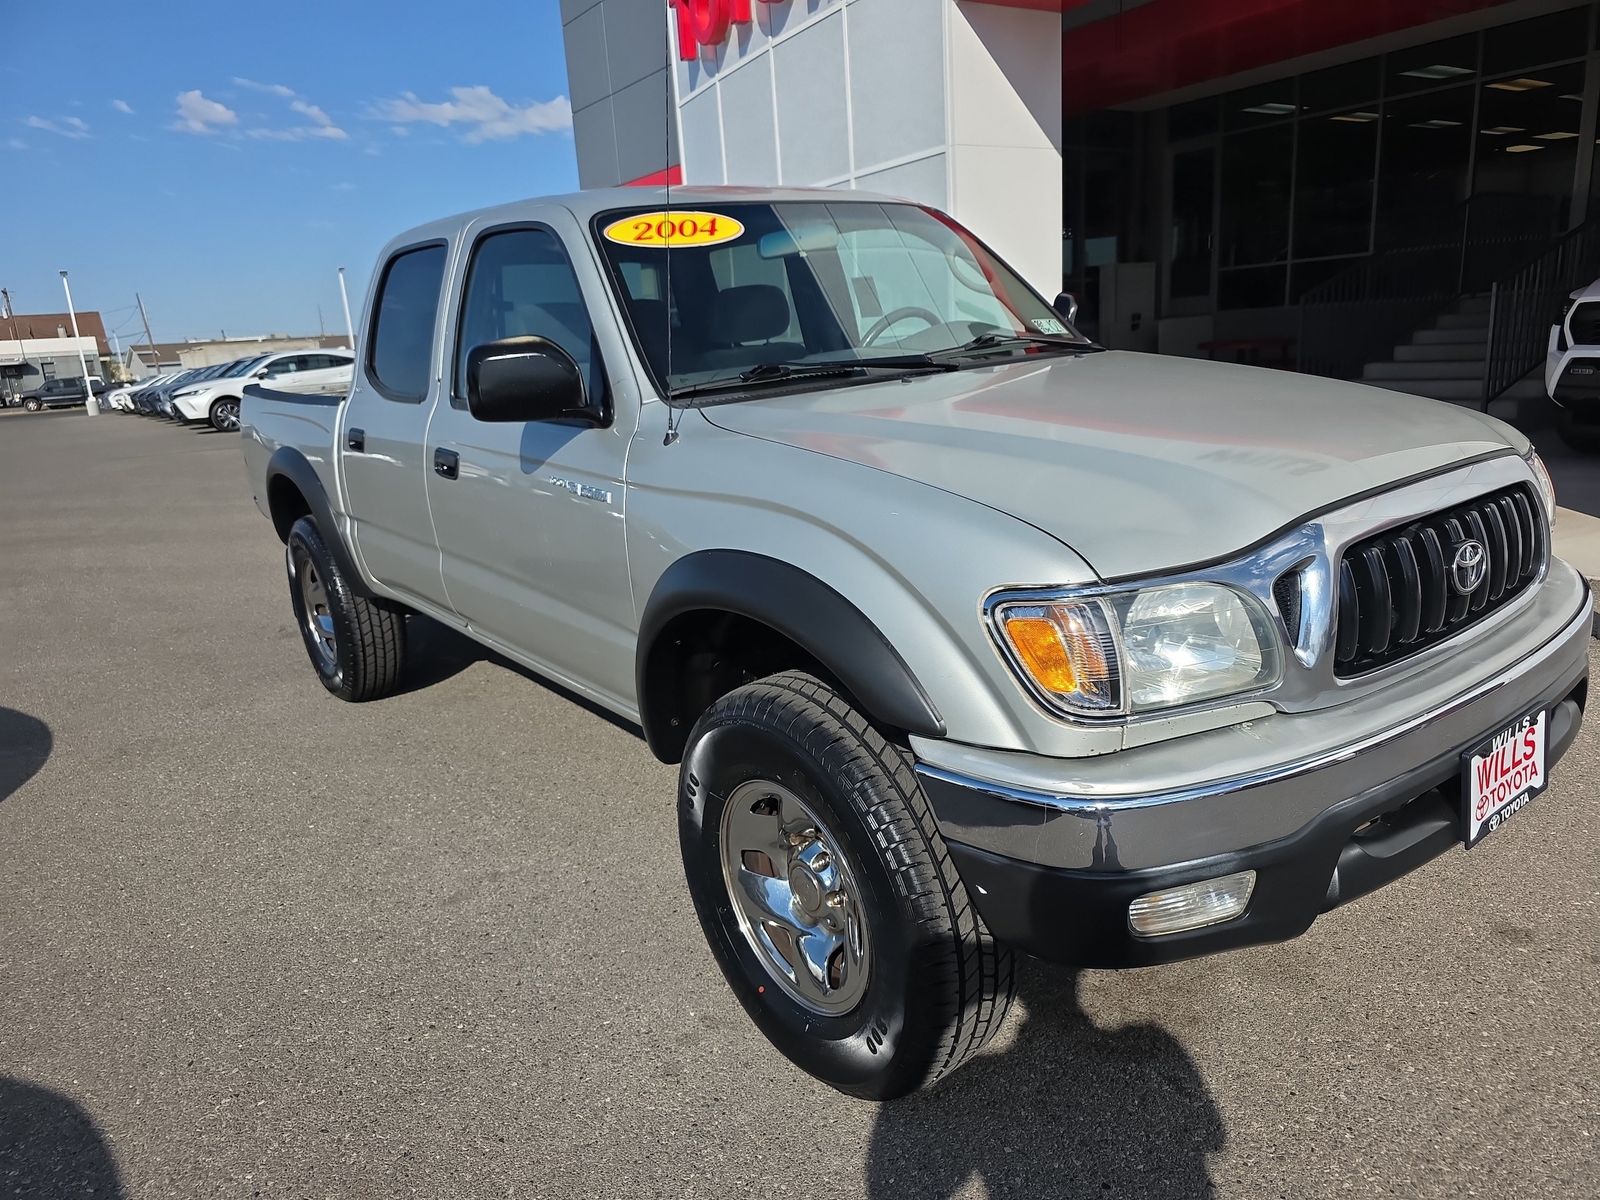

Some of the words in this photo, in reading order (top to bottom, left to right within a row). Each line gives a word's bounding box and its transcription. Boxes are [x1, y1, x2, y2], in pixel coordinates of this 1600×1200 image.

[632, 217, 718, 241] 2004
[1492, 716, 1531, 751] WILLS
[1477, 727, 1536, 795] WILLS
[1490, 761, 1538, 807] TOYOTA
[1500, 792, 1530, 821] TOYOTA
